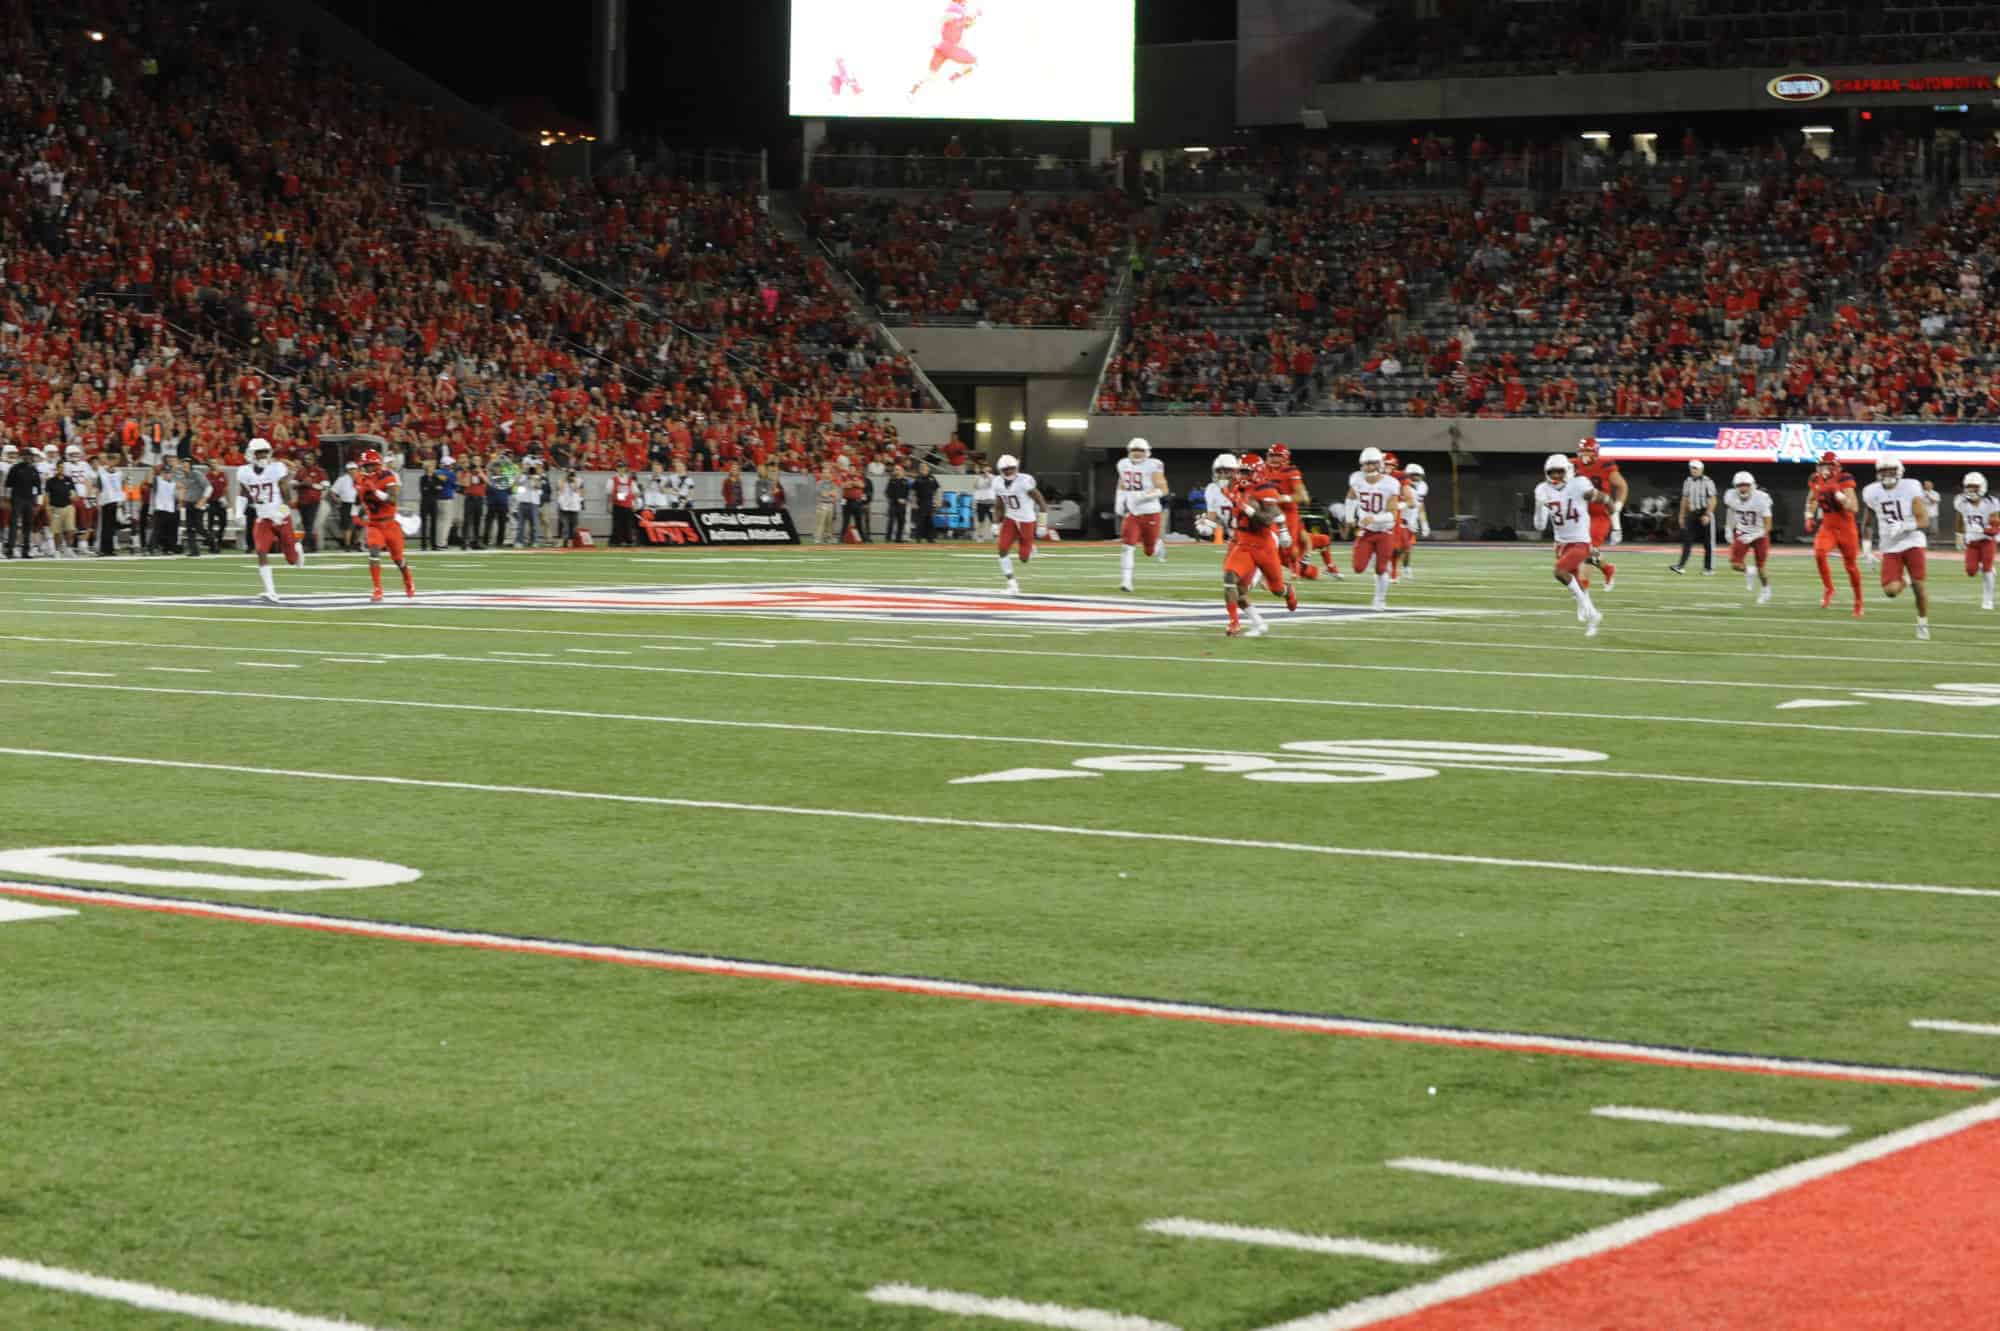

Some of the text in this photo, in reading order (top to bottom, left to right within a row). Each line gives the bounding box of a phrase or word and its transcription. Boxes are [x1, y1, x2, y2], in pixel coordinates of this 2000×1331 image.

[1715, 427, 1782, 451] BEAR
[1811, 429, 1892, 452] DOWN
[248, 482, 273, 504] 27
[1359, 492, 1383, 514] 50
[1545, 498, 1580, 527] 34
[1880, 501, 1904, 524] 51
